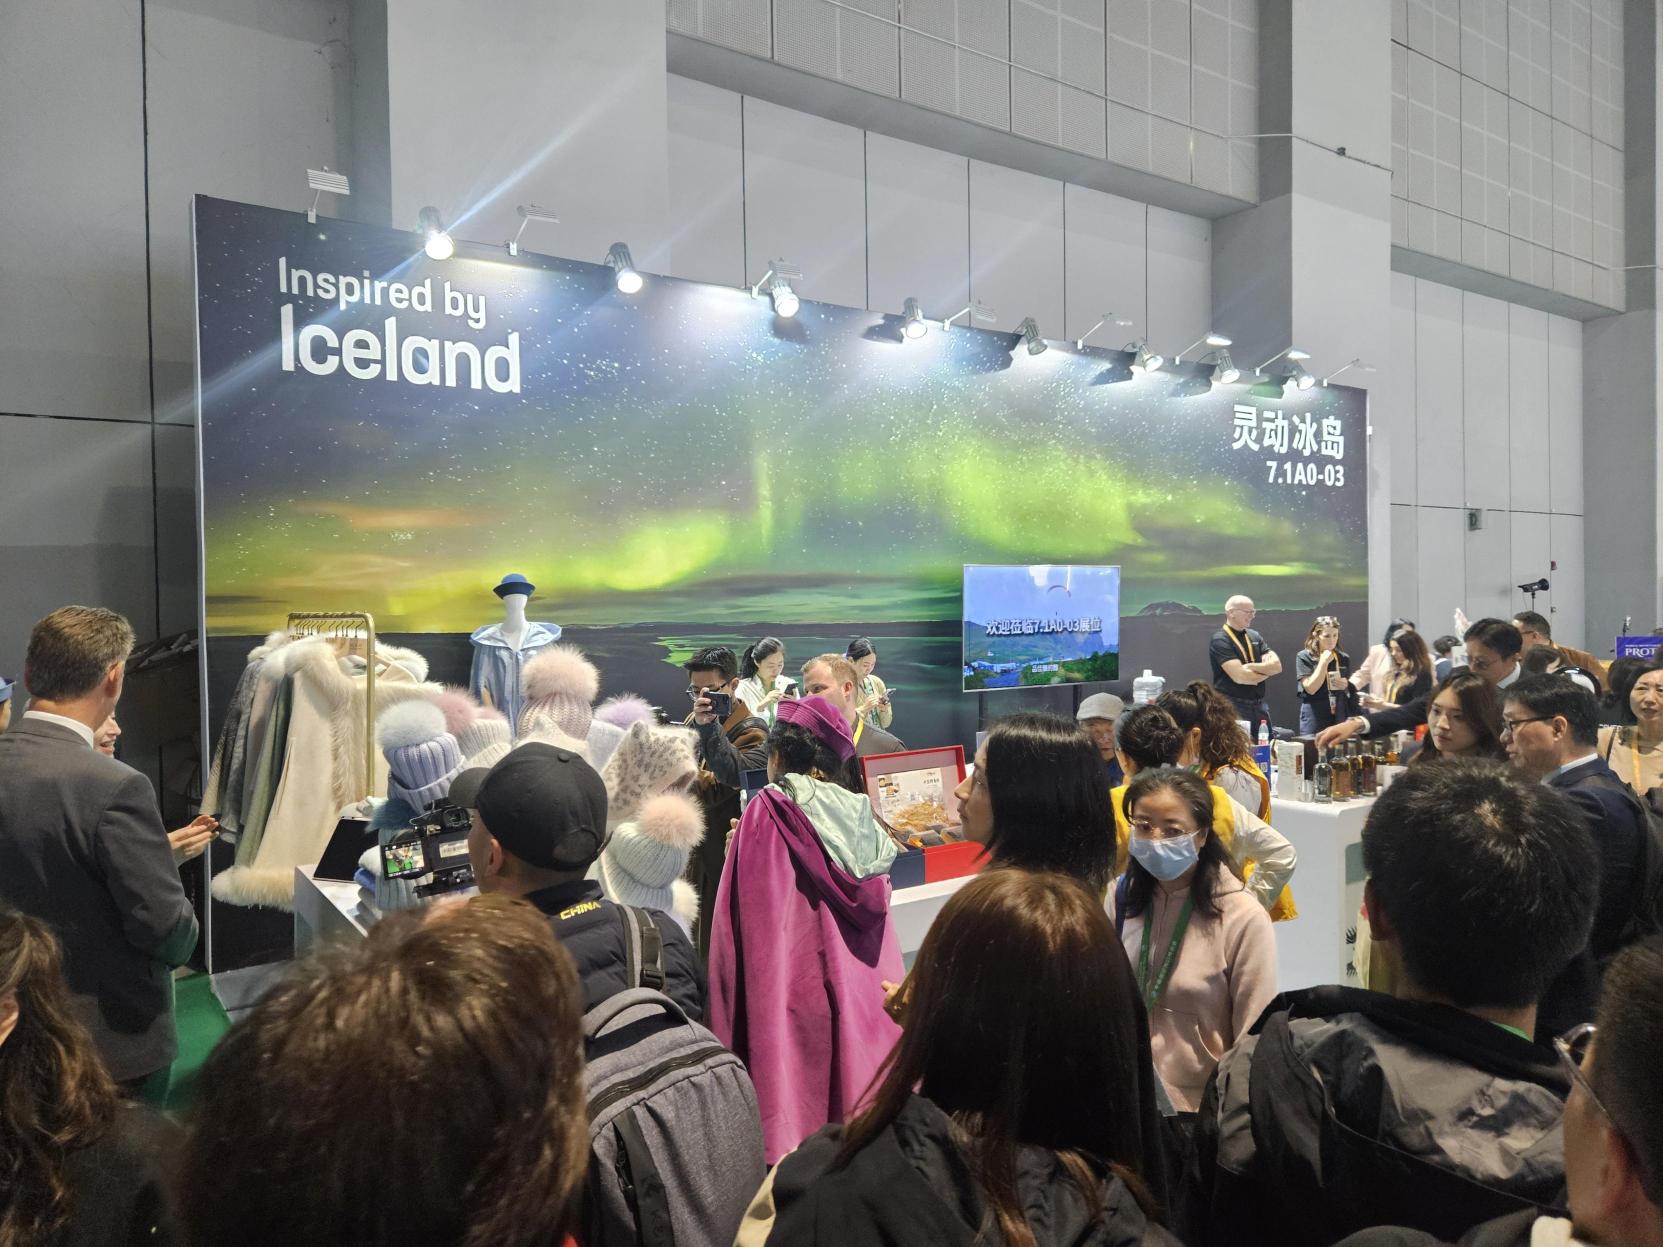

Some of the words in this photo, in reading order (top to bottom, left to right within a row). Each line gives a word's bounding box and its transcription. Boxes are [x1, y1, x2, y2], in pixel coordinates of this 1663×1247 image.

[279, 256, 432, 312] Inspired
[444, 280, 486, 329] by
[280, 303, 521, 394] Iceland
[1232, 404, 1345, 460] 灵动冰岛
[1266, 460, 1345, 487] 7.1A0-03
[560, 901, 602, 920] CHINA
